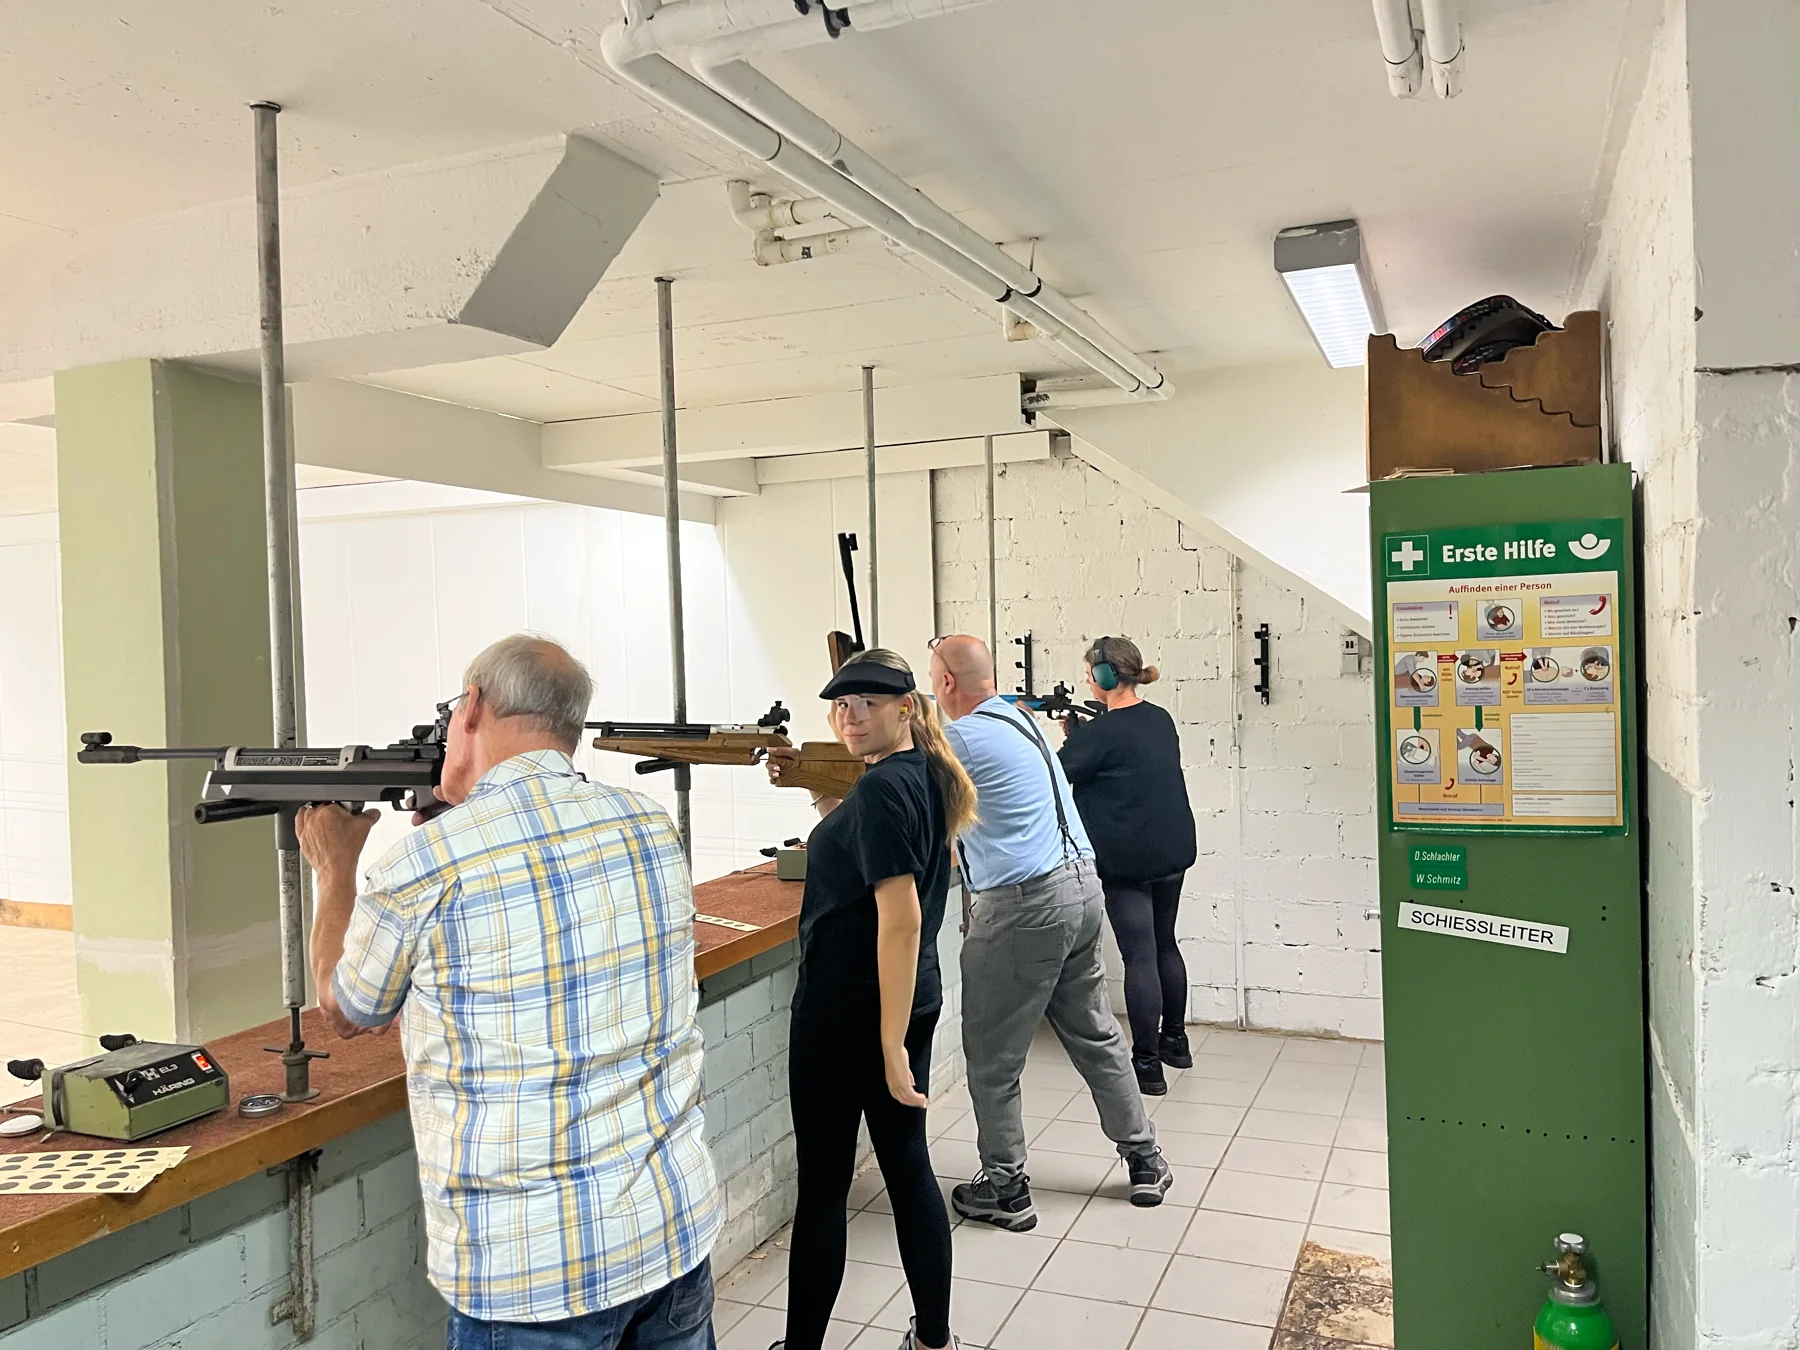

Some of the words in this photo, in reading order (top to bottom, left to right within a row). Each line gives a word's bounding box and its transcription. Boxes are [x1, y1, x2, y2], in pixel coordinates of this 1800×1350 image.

[1442, 544, 1498, 563] Erste
[1504, 539, 1556, 560] Hilfe
[1449, 585, 1492, 594] Auffinden
[1495, 584, 1517, 592] einer
[1520, 582, 1552, 591] Person
[1411, 910, 1554, 945] SCHIESSLEITER
[152, 1078, 195, 1095] HÄRING
